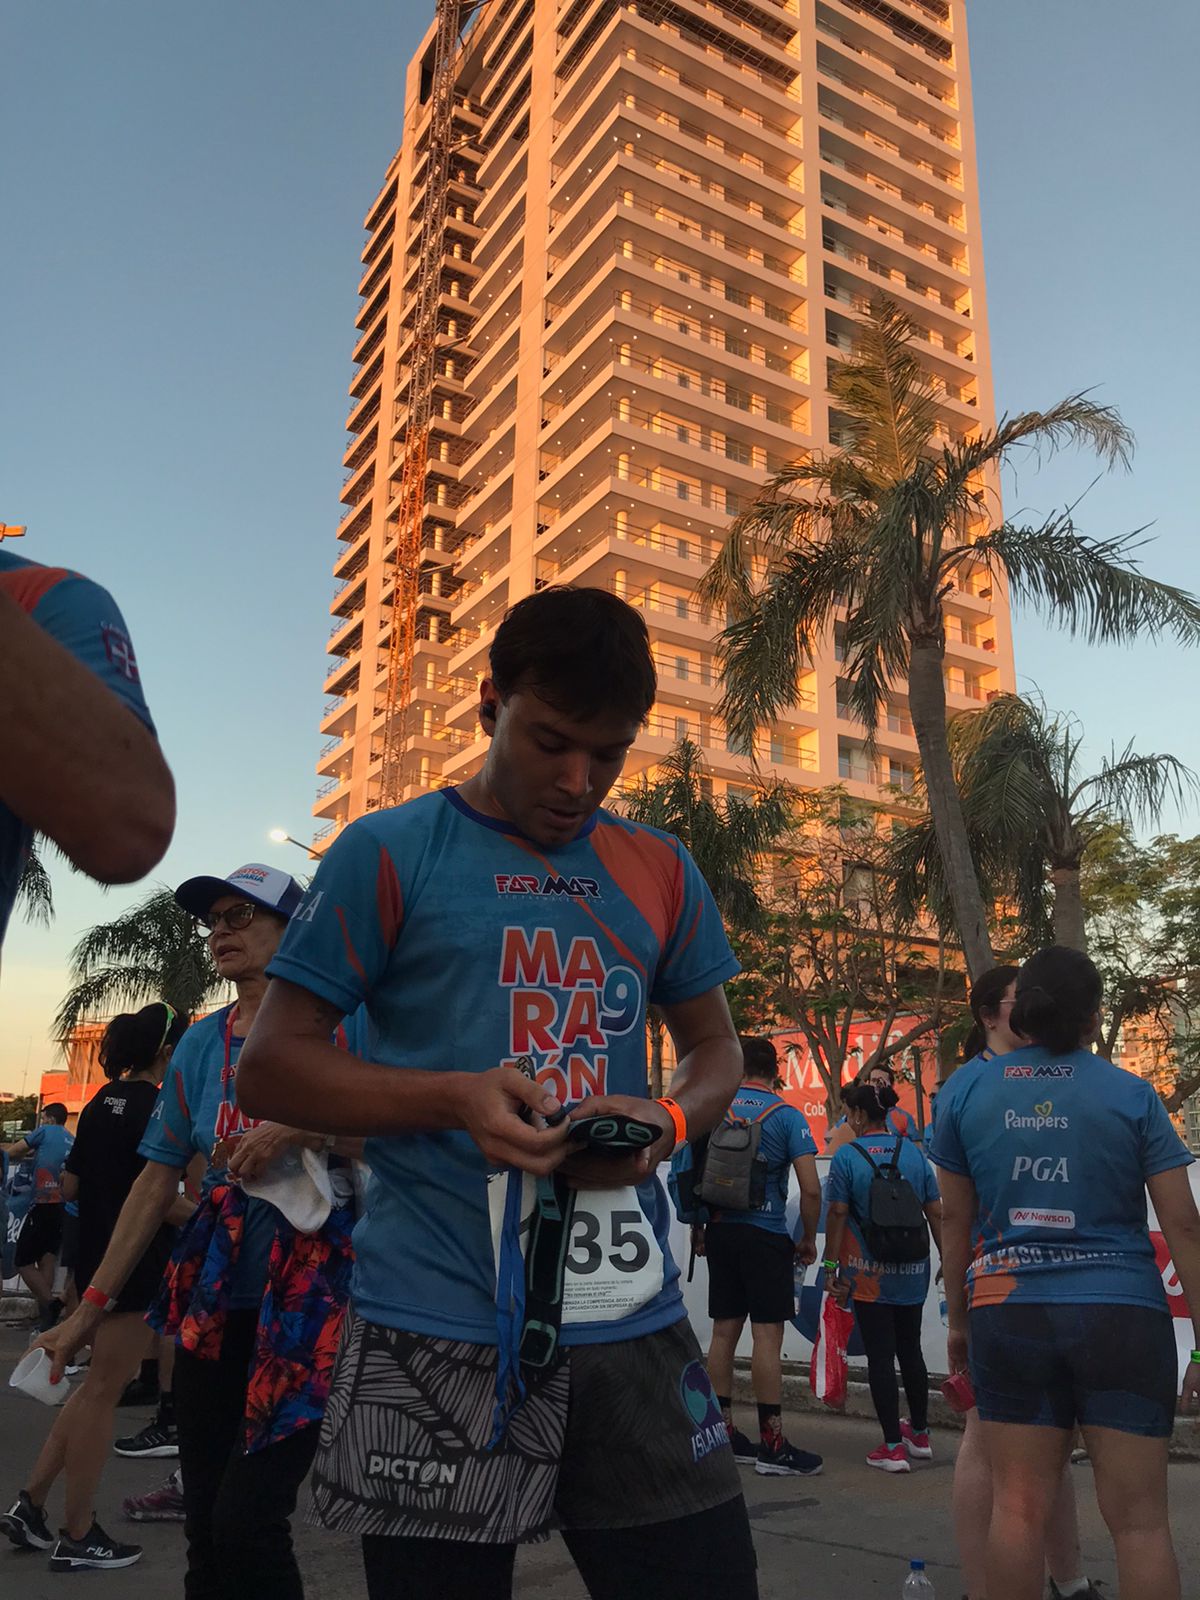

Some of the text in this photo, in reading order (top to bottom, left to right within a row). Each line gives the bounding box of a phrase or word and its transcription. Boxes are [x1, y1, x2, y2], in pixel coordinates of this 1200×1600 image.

[498, 926, 607, 991] MA
[599, 965, 642, 1036] 9
[510, 987, 608, 1056] RA
[500, 1052, 609, 1107] ÓN
[103, 1096, 127, 1107] POWER
[804, 1103, 827, 1117] Cob
[1005, 1109, 1069, 1131] Pampers
[1011, 1156, 1070, 1183] PGA
[1031, 1212, 1072, 1223] Newsan
[86, 1546, 114, 1559] FILA
